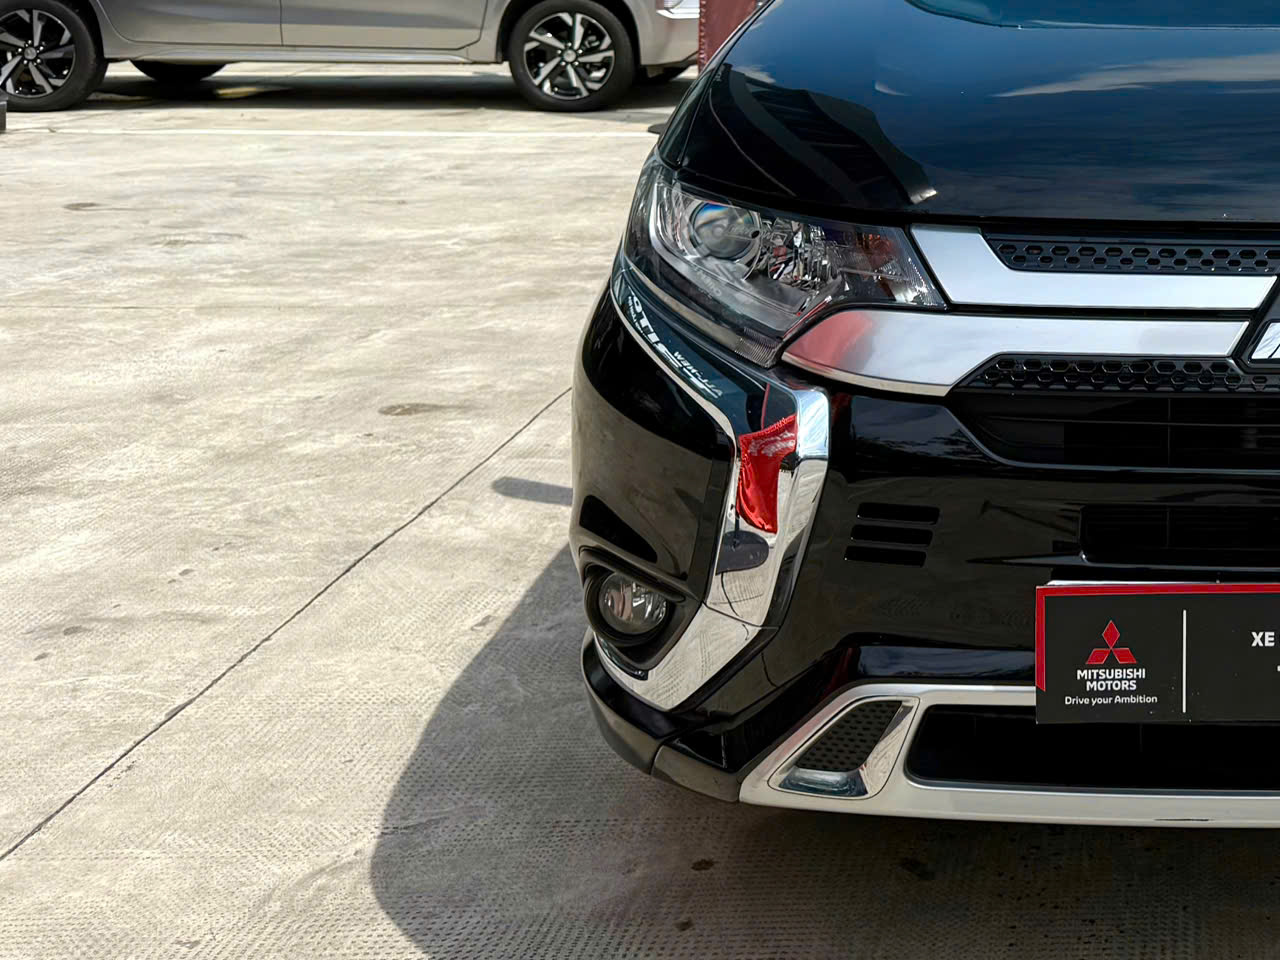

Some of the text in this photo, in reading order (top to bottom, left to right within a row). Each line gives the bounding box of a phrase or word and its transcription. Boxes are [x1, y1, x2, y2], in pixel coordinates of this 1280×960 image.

[1251, 631, 1275, 647] XE
[1076, 668, 1146, 680] MITSUBISHI
[1086, 680, 1137, 691] MOTORS
[1064, 695, 1158, 706] Drive your Ambition
